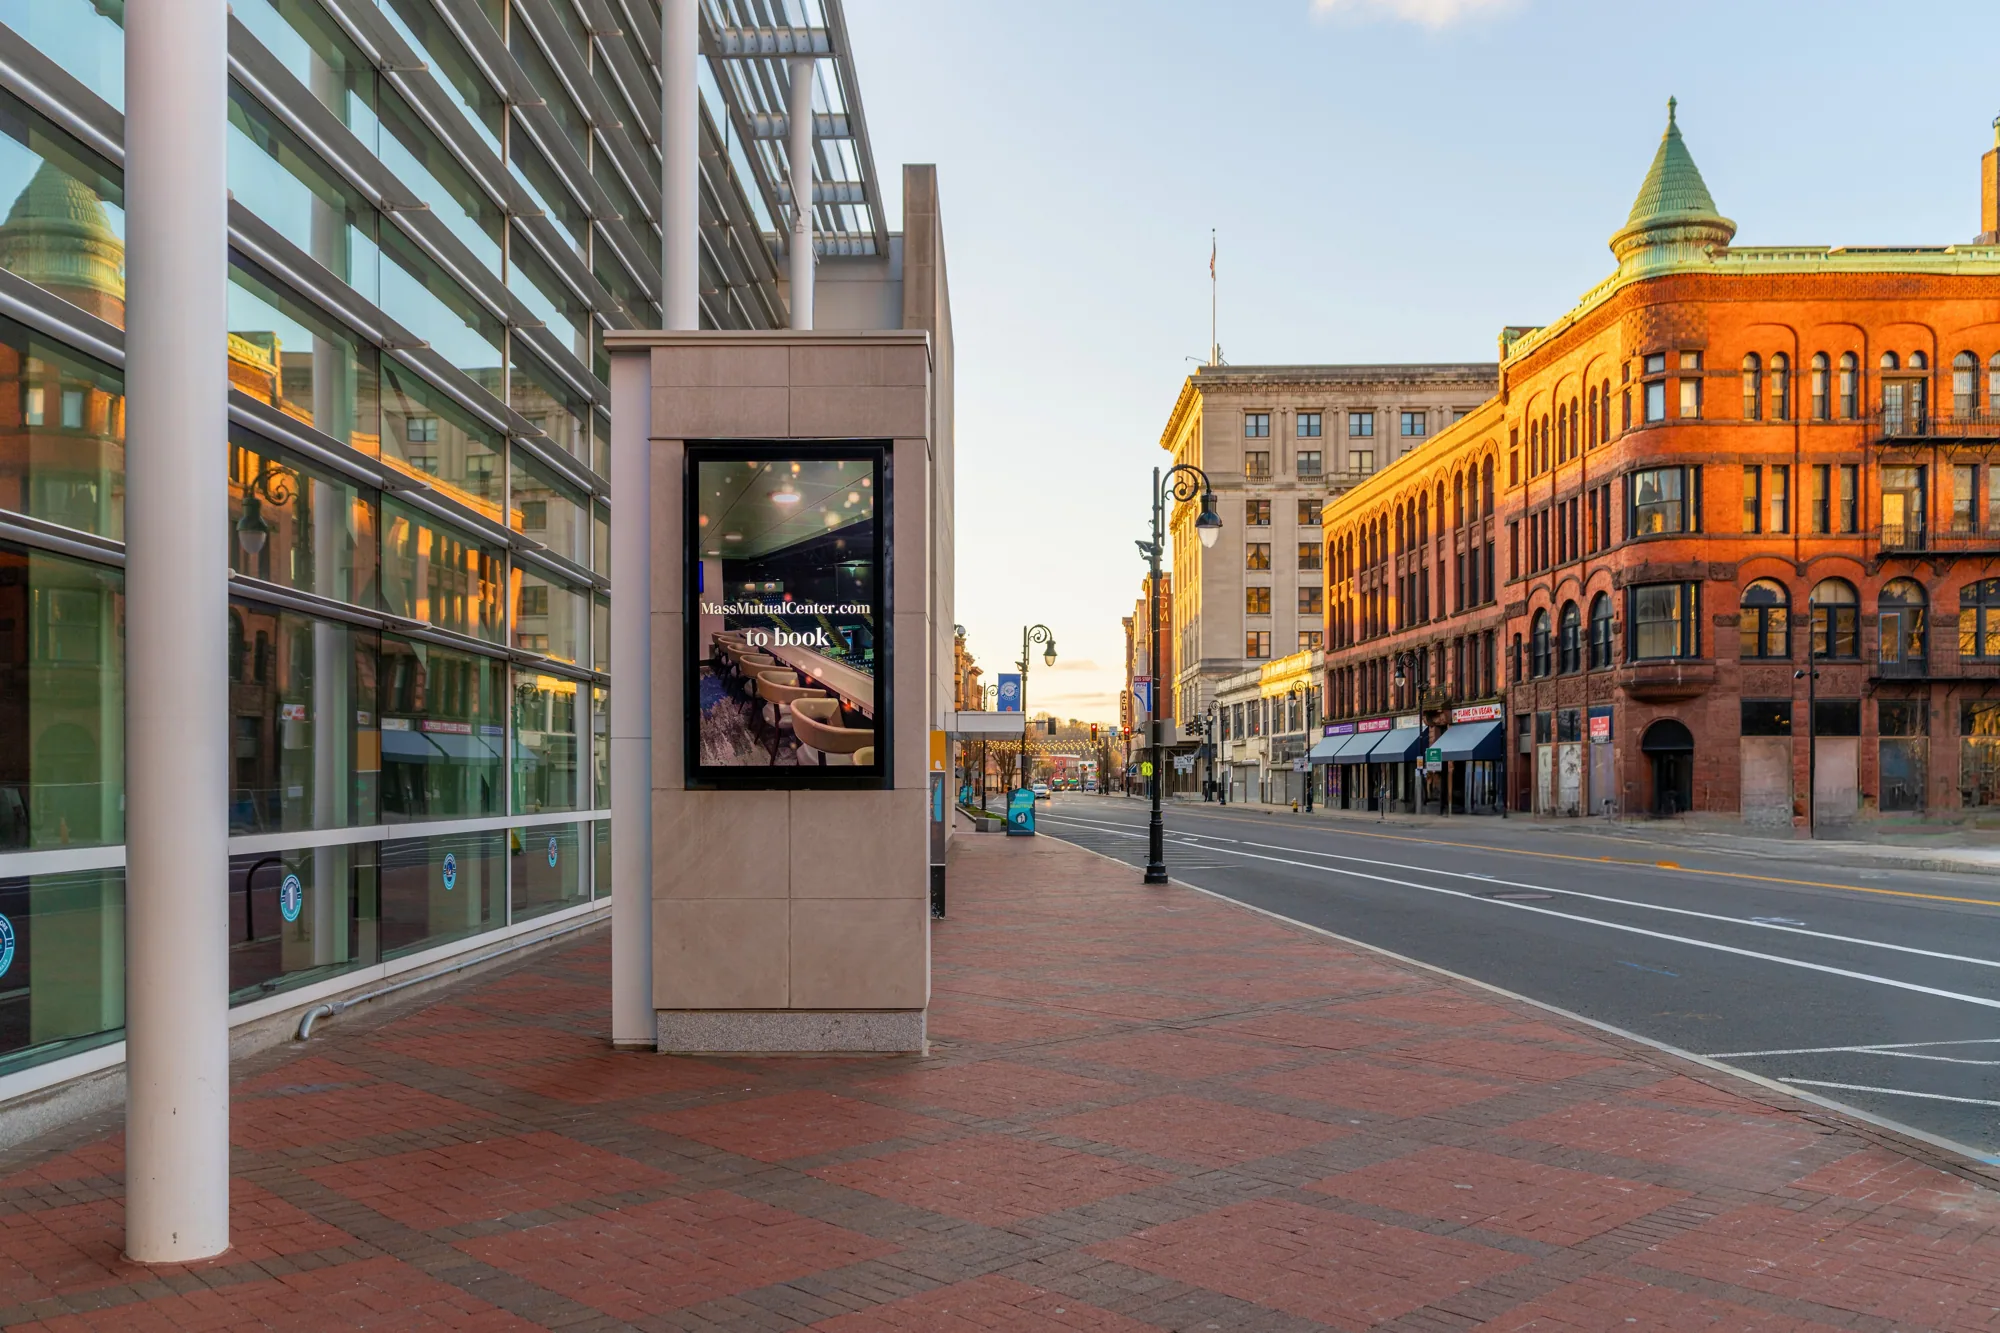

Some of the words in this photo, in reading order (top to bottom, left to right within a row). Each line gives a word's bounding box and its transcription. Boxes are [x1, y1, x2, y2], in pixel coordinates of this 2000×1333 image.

[701, 601, 871, 616] MassMutualCenter.com
[745, 628, 768, 647] to
[774, 627, 830, 647] book
[1457, 708, 1471, 718] FLAME
[1471, 707, 1478, 717] ON
[1478, 706, 1493, 715] VEGAN
[288, 886, 294, 910] 1
